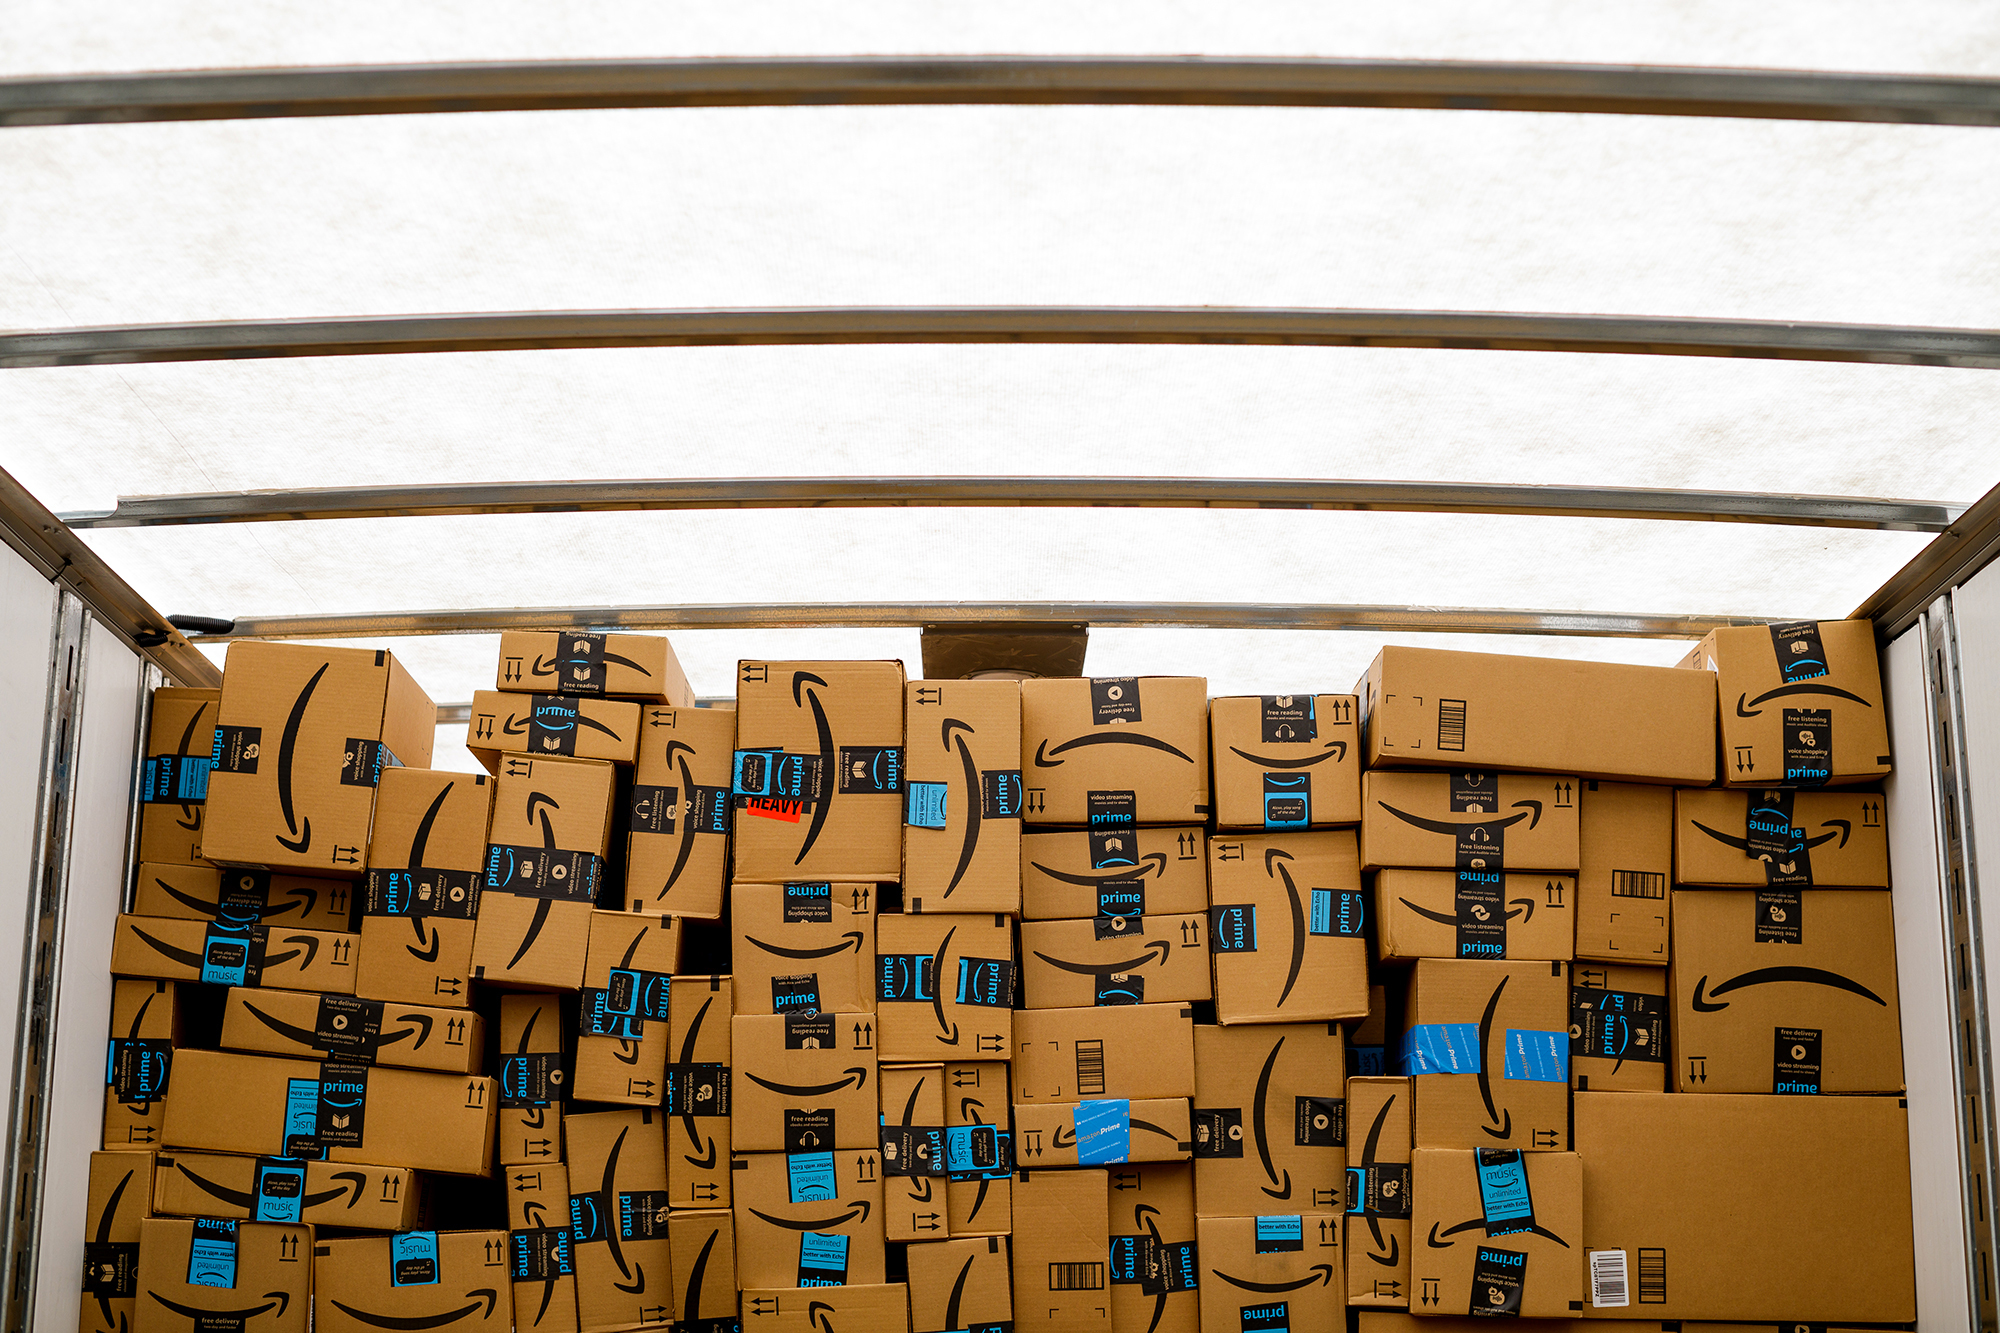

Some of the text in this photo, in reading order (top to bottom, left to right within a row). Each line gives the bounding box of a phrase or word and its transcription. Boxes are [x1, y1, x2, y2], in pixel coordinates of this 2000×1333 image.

[1778, 631, 1800, 639] delivery
[577, 682, 600, 690] reading
[211, 729, 224, 770] prime
[234, 746, 242, 770] shopping
[160, 758, 174, 796] prime
[791, 756, 806, 797] prime
[885, 749, 901, 790] prime
[1787, 766, 1828, 779] prime
[651, 790, 660, 814] listening
[694, 790, 702, 814] shopping
[996, 774, 1012, 814] prime
[711, 791, 725, 831] prime
[750, 798, 801, 816] HEAVY
[1092, 811, 1132, 825] prime
[1749, 820, 1788, 835] prime
[486, 846, 501, 887] prime
[536, 852, 546, 874] delivery
[368, 872, 376, 897] shopping
[436, 874, 444, 896] delivery
[1460, 871, 1499, 885] prime
[386, 872, 400, 913] prime
[788, 884, 829, 899] prime
[1101, 891, 1141, 906] prime
[1337, 893, 1352, 933] prime
[1230, 909, 1246, 949] prime
[1759, 929, 1784, 937] listening
[1462, 940, 1502, 955] prime
[208, 970, 237, 980] music
[881, 957, 896, 998] prime
[984, 963, 1002, 1004] prime
[338, 1000, 362, 1009] delivery
[776, 992, 816, 1008] prime
[591, 992, 605, 1034] prime
[317, 1030, 359, 1042] video streaming
[1601, 1014, 1615, 1055] prime
[1794, 1030, 1817, 1038] delivery
[138, 1052, 151, 1092] prime
[516, 1058, 530, 1098] prime
[323, 1080, 364, 1094] prime
[1777, 1080, 1818, 1094] prime
[926, 1130, 944, 1172] prime
[957, 1132, 968, 1164] music
[796, 1174, 828, 1184] unlimited
[1486, 1167, 1518, 1180] music
[1489, 1188, 1521, 1199] unlimited
[264, 1201, 294, 1212] music
[1486, 1204, 1502, 1212] better
[1515, 1200, 1528, 1208] Echo
[571, 1199, 587, 1240] prime
[619, 1196, 635, 1237] prime
[400, 1244, 430, 1256] music
[809, 1239, 841, 1248] unlimited
[515, 1235, 531, 1277] prime
[1122, 1238, 1137, 1279] prime
[1480, 1251, 1523, 1268] prime
[197, 1262, 230, 1270] unlimited
[1180, 1247, 1197, 1288] prime
[1478, 1276, 1520, 1288] voice shopping
[215, 1318, 240, 1326] delivery
[1244, 1305, 1285, 1321] prime
